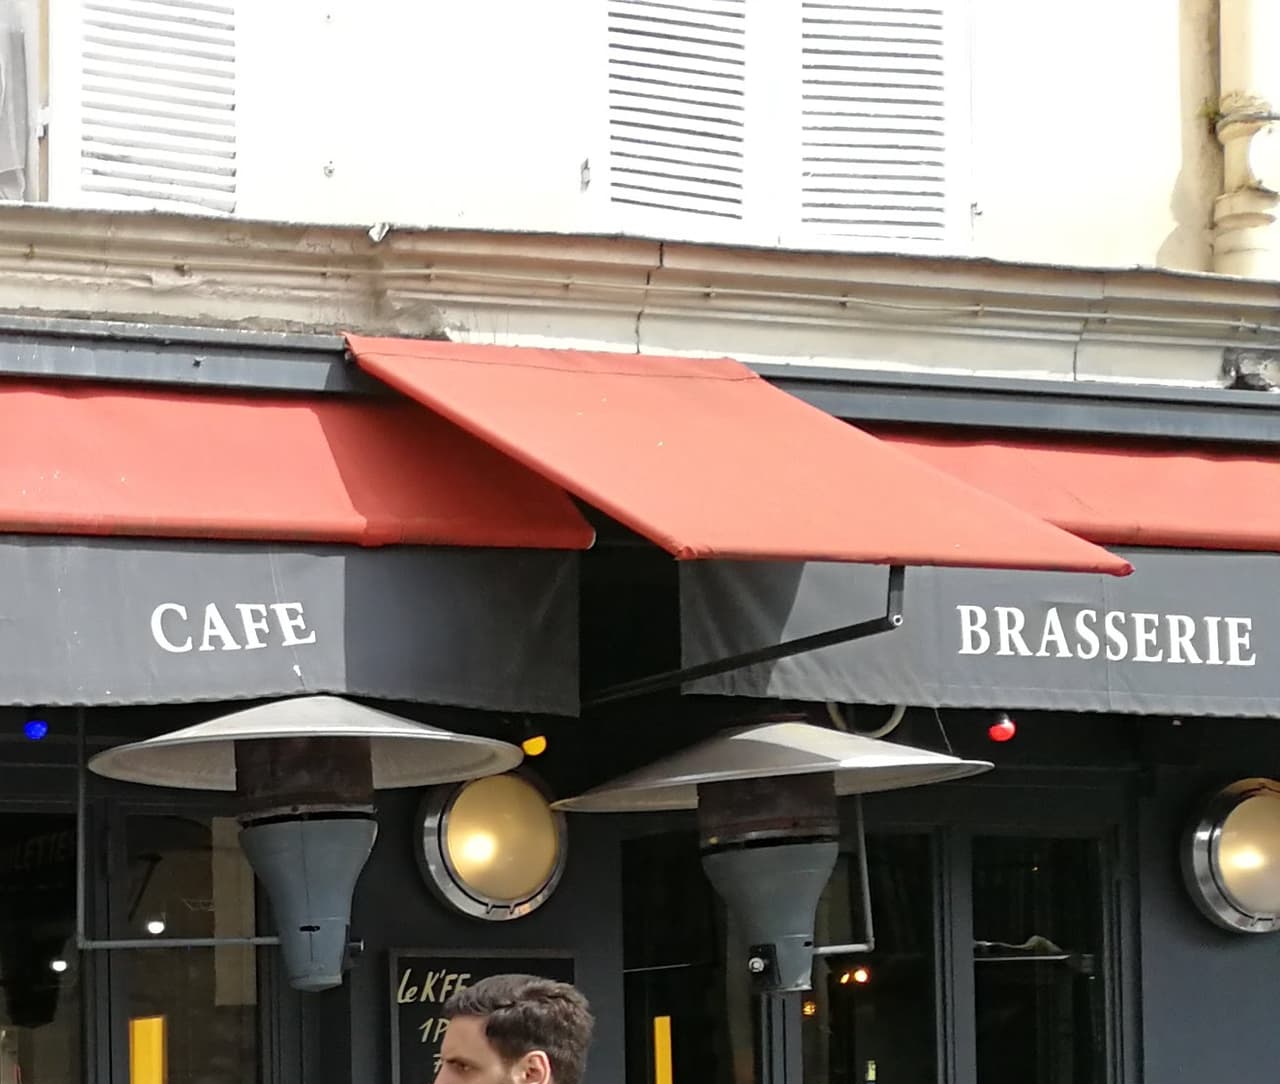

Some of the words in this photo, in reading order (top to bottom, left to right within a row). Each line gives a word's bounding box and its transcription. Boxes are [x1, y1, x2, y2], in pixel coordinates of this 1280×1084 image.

[150, 601, 317, 653] CAFE
[956, 604, 1257, 666] BRASSERIE
[397, 968, 418, 1004] Le
